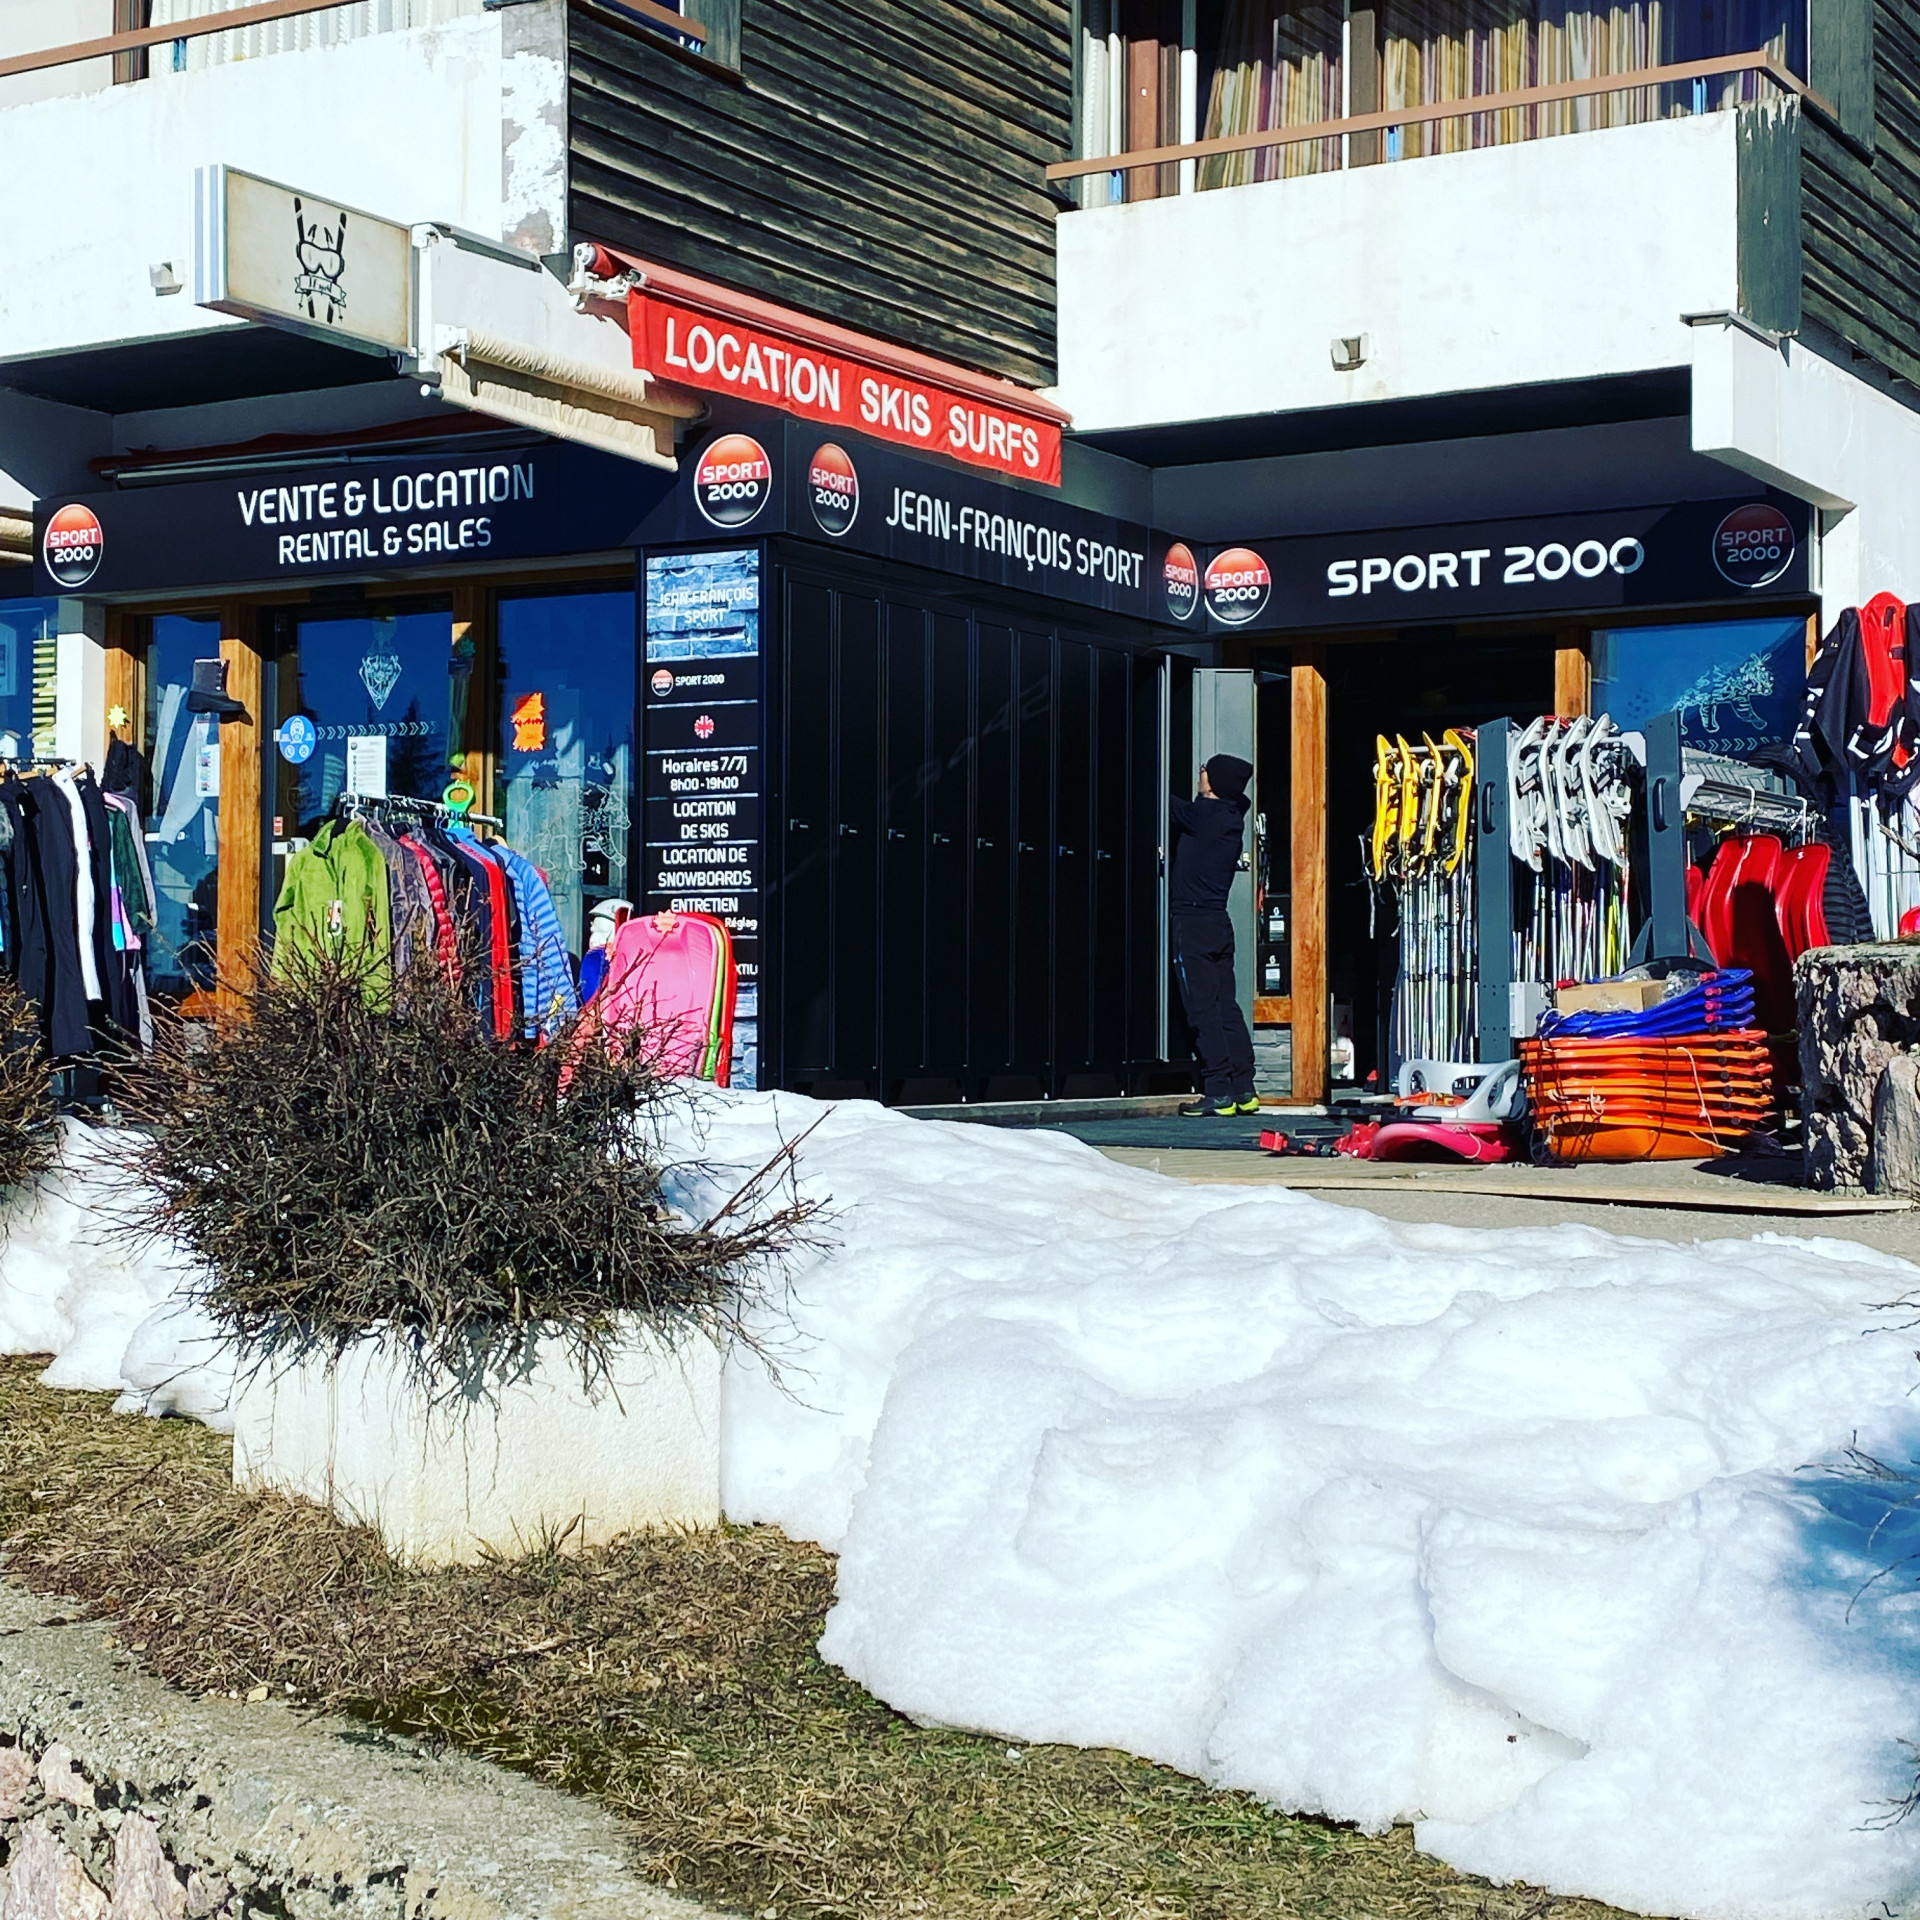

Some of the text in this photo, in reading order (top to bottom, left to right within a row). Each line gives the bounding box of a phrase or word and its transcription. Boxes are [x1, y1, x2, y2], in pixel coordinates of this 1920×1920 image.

[665, 318, 1040, 468] LOCATION SKIS SURFS
[702, 461, 765, 483] SPORT
[811, 468, 854, 495] SPORT
[237, 463, 534, 526] VENTE & LOCATION
[707, 481, 758, 501] 2000
[815, 488, 850, 511] 2000
[50, 528, 98, 546] SPORT
[278, 517, 492, 565] RENTAL & SALES
[885, 487, 1144, 589] JEAN-FRANÇOIS SPORT
[1721, 527, 1787, 547] SPORT
[54, 545, 94, 563] 2000
[1726, 545, 1781, 563] 2000
[1165, 564, 1194, 583] SPORT
[1327, 537, 1645, 597] SPORT 2000
[1209, 570, 1266, 587] SPORT
[656, 587, 754, 607] JEAN-FRANÇOIS
[1167, 581, 1192, 598] 2000
[1214, 586, 1260, 603] 2000
[684, 608, 726, 624] SPORT
[675, 675, 702, 686] SPORT
[702, 674, 725, 685] 2000
[662, 755, 748, 775] Horaires 7/7j
[670, 778, 699, 791] 8h00
[705, 776, 739, 790] 19h00
[673, 801, 736, 818] LOCATION
[680, 823, 729, 839] DE SKIS
[662, 847, 748, 865] LOCATION DE
[658, 870, 752, 887] SNOWBOARDS
[671, 897, 738, 913] ENTRETIEN
